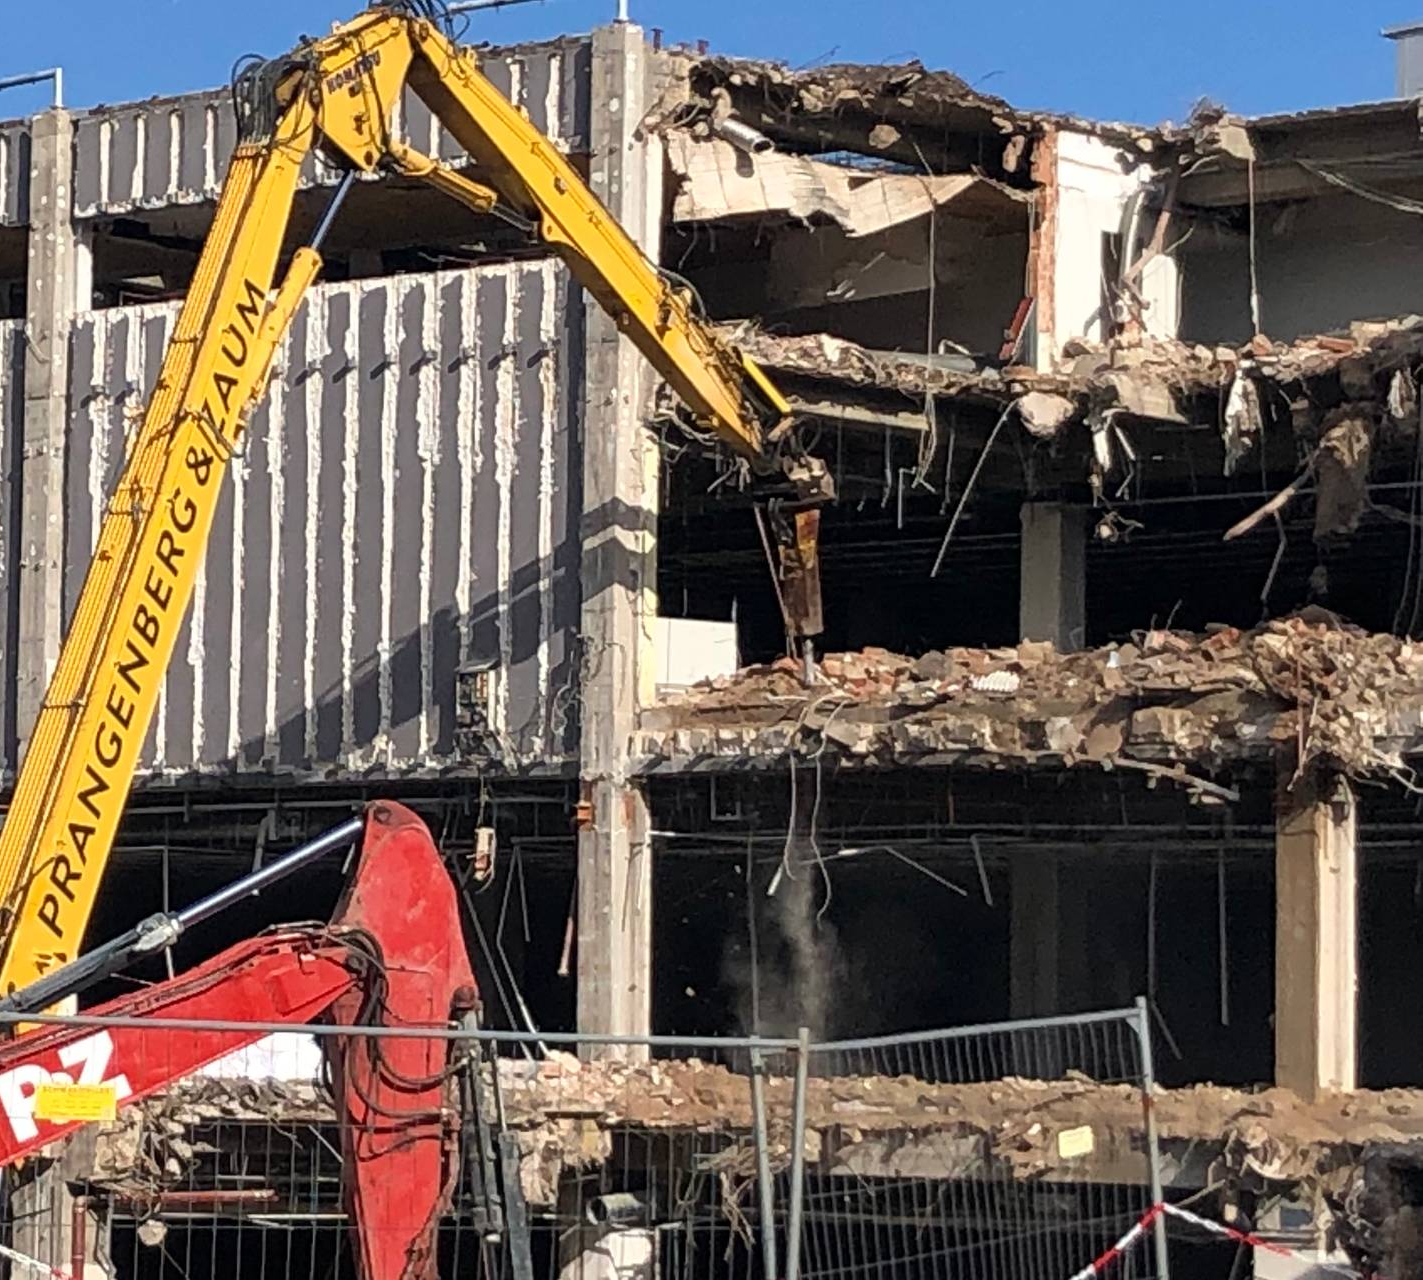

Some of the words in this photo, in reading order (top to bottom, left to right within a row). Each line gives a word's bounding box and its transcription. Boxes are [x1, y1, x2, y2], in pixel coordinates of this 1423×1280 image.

[38, 496, 197, 939] PRANGENBERG
[186, 445, 214, 486] &
[202, 278, 266, 441] ZAUM
